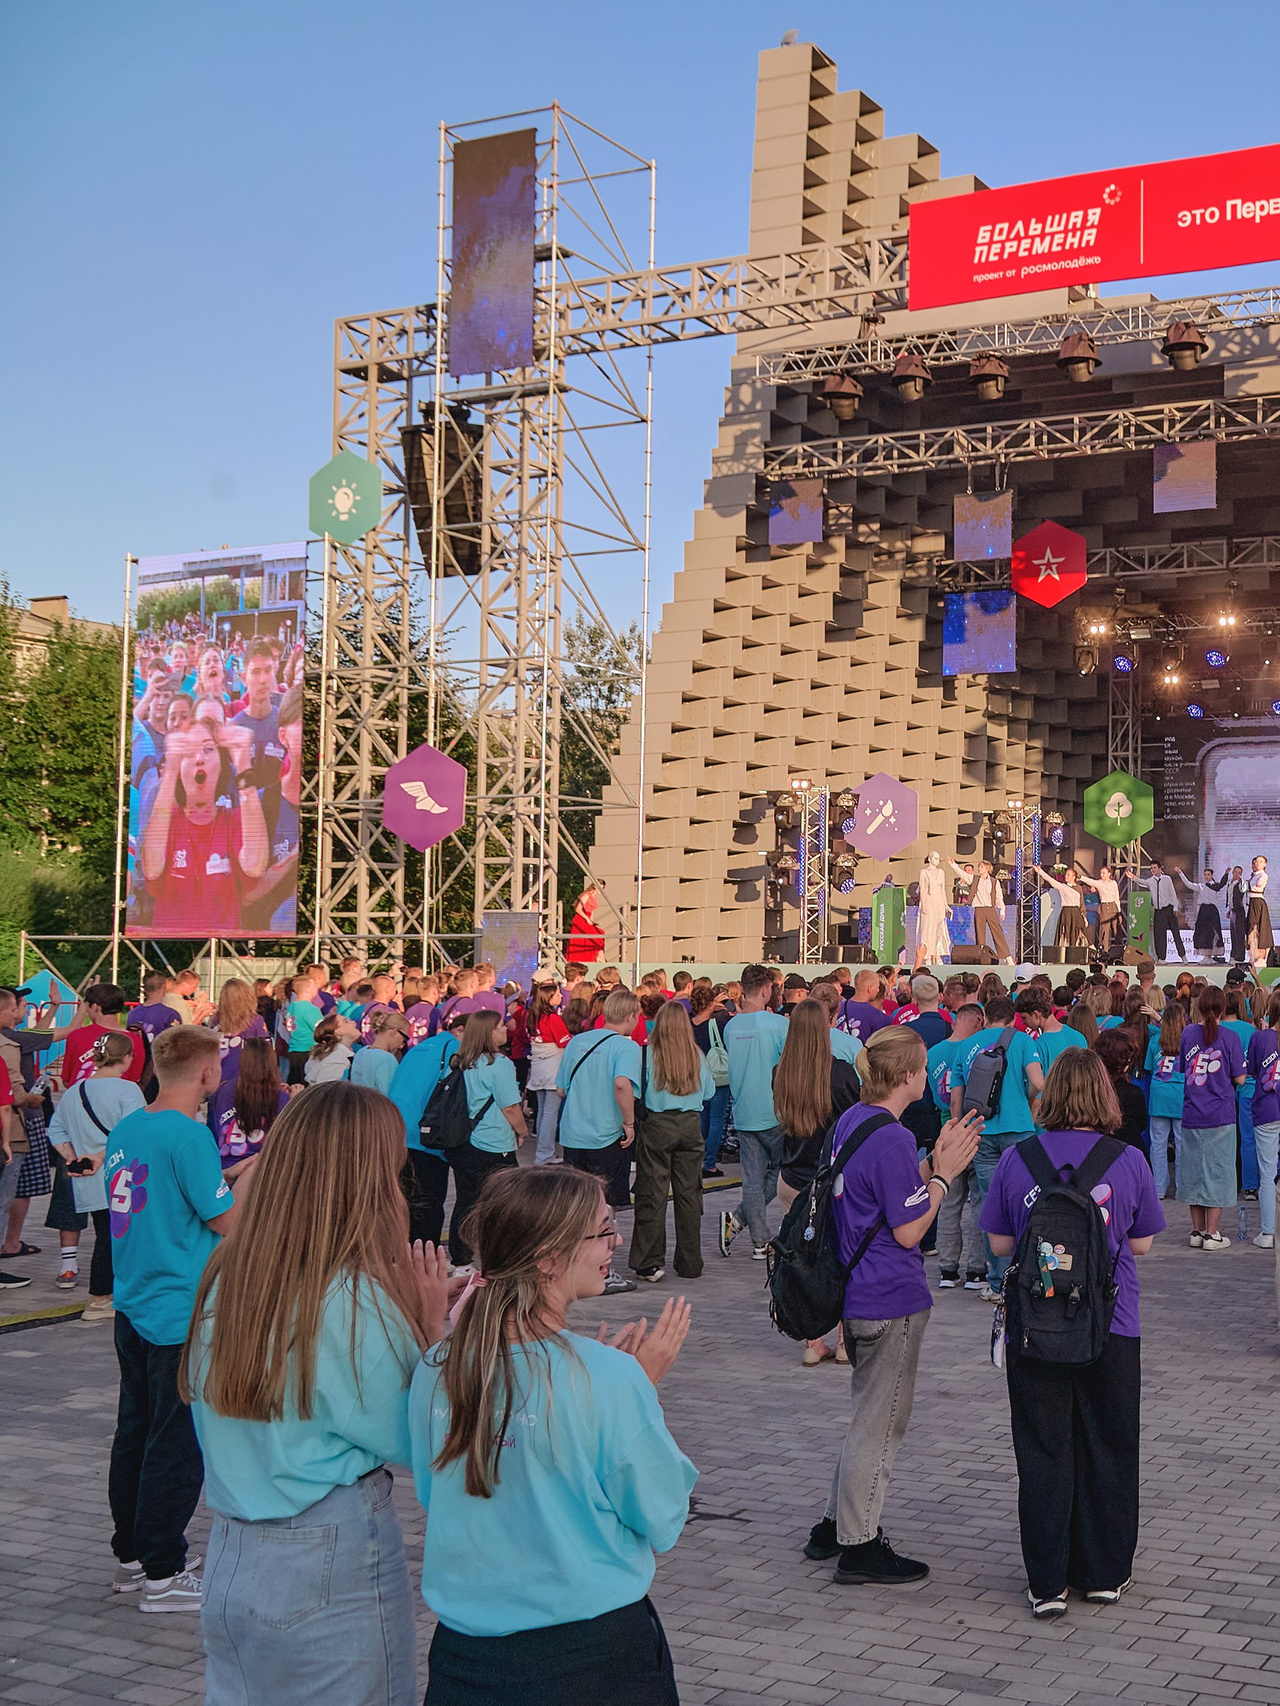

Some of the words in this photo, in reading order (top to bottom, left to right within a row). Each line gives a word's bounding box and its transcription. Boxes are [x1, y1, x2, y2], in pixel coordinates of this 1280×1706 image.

[976, 207, 1102, 244] БОЛЬШАЯ
[1177, 206, 1220, 228] это
[973, 228, 1098, 264] ПЕРЕМЕНА
[973, 271, 1004, 284] проект
[1005, 269, 1017, 278] от
[1185, 1044, 1201, 1061] СЕЗОН
[1261, 1051, 1279, 1067] СЕЗОН
[933, 1061, 947, 1079] СЕЗОН
[1161, 1056, 1175, 1073] 5
[110, 1168, 133, 1214] 5
